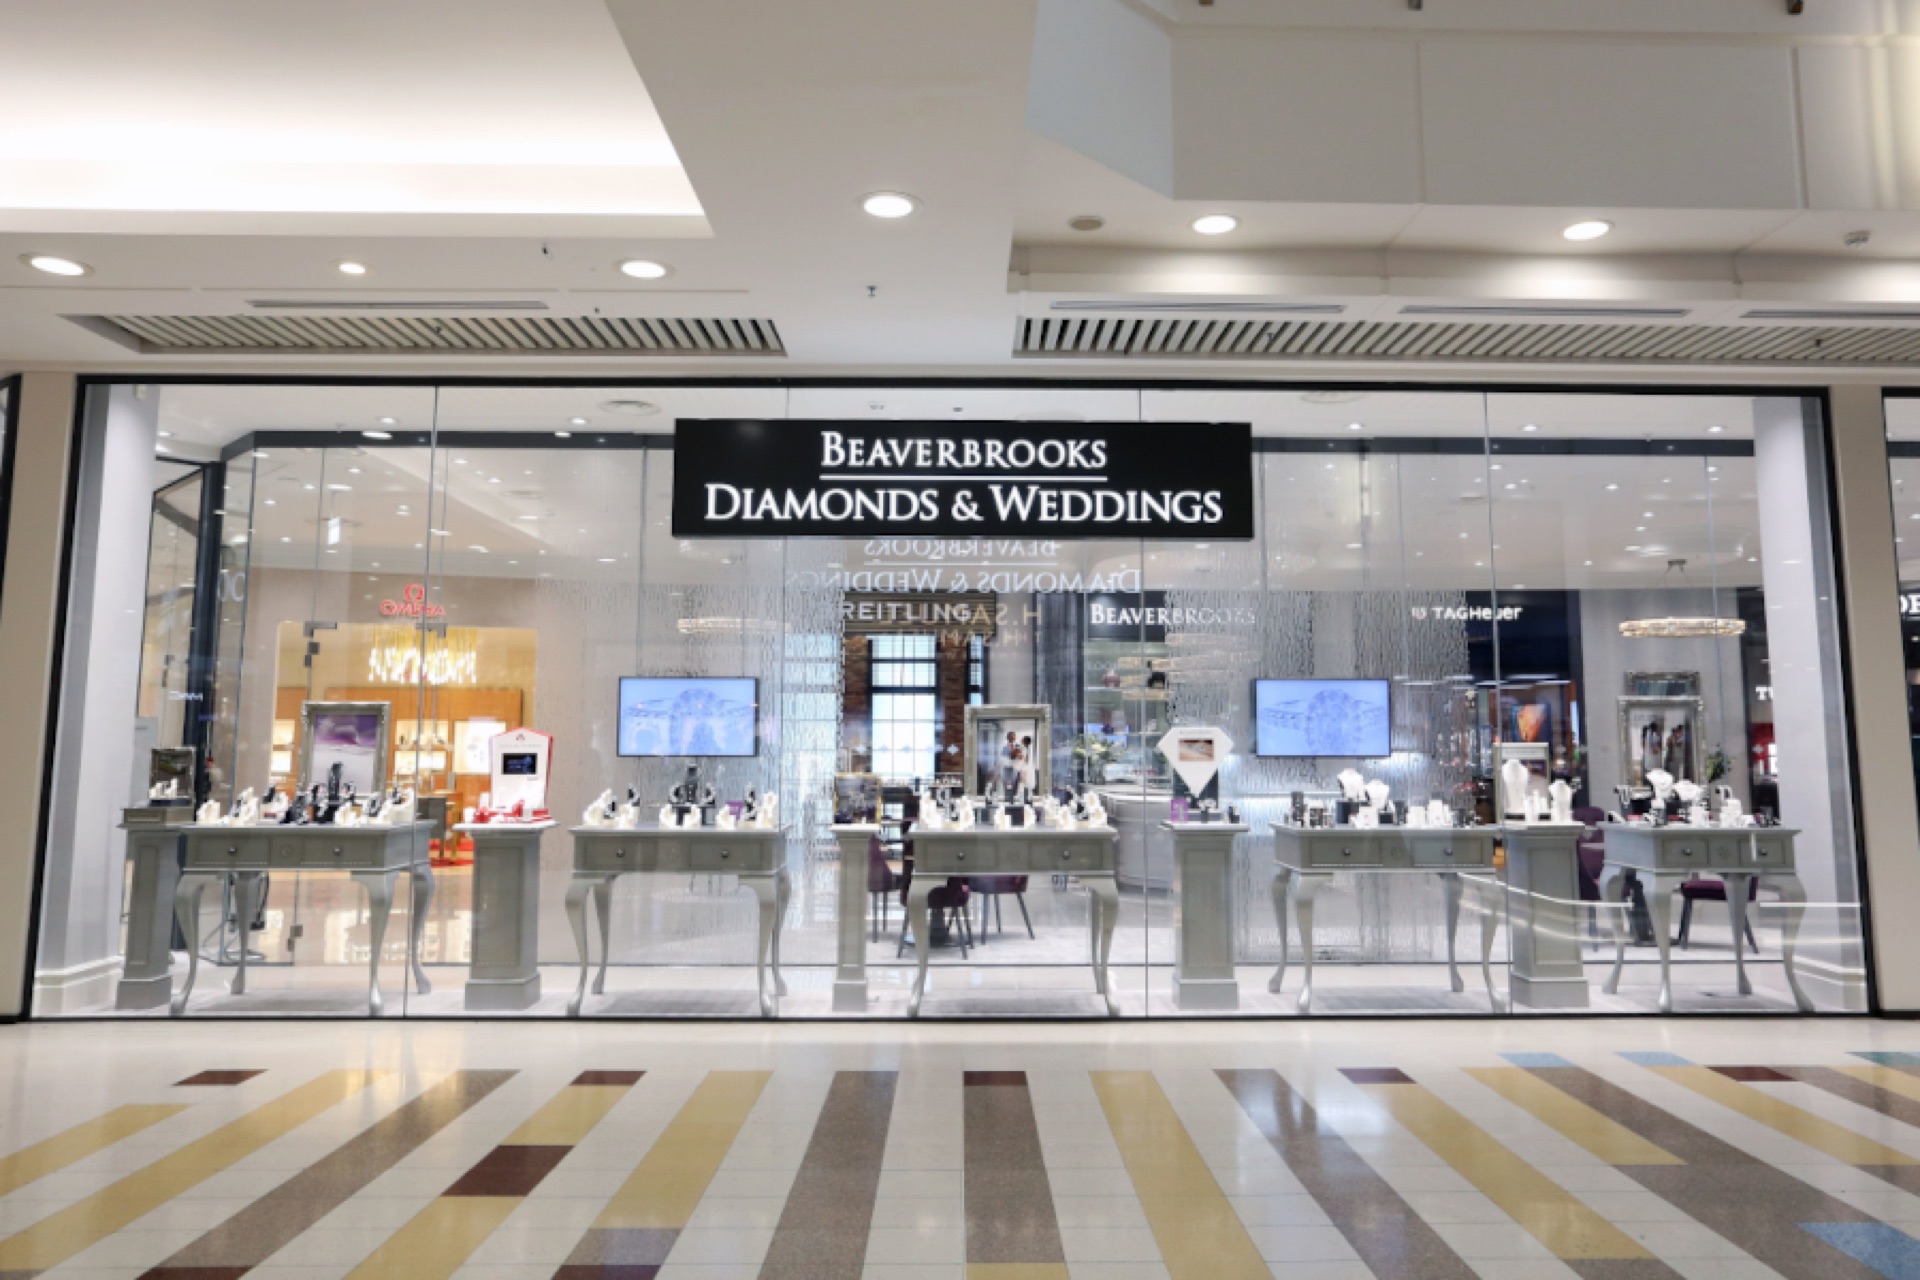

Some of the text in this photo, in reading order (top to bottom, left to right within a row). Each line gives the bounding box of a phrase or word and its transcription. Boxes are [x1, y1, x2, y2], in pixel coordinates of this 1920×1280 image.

[820, 430, 1108, 470] BEAVERBROOKS
[704, 483, 1223, 525] DIAMONDS & WEDDINGS
[843, 602, 973, 622] REITLING
[1090, 602, 1256, 626] BEAVERBROOKS
